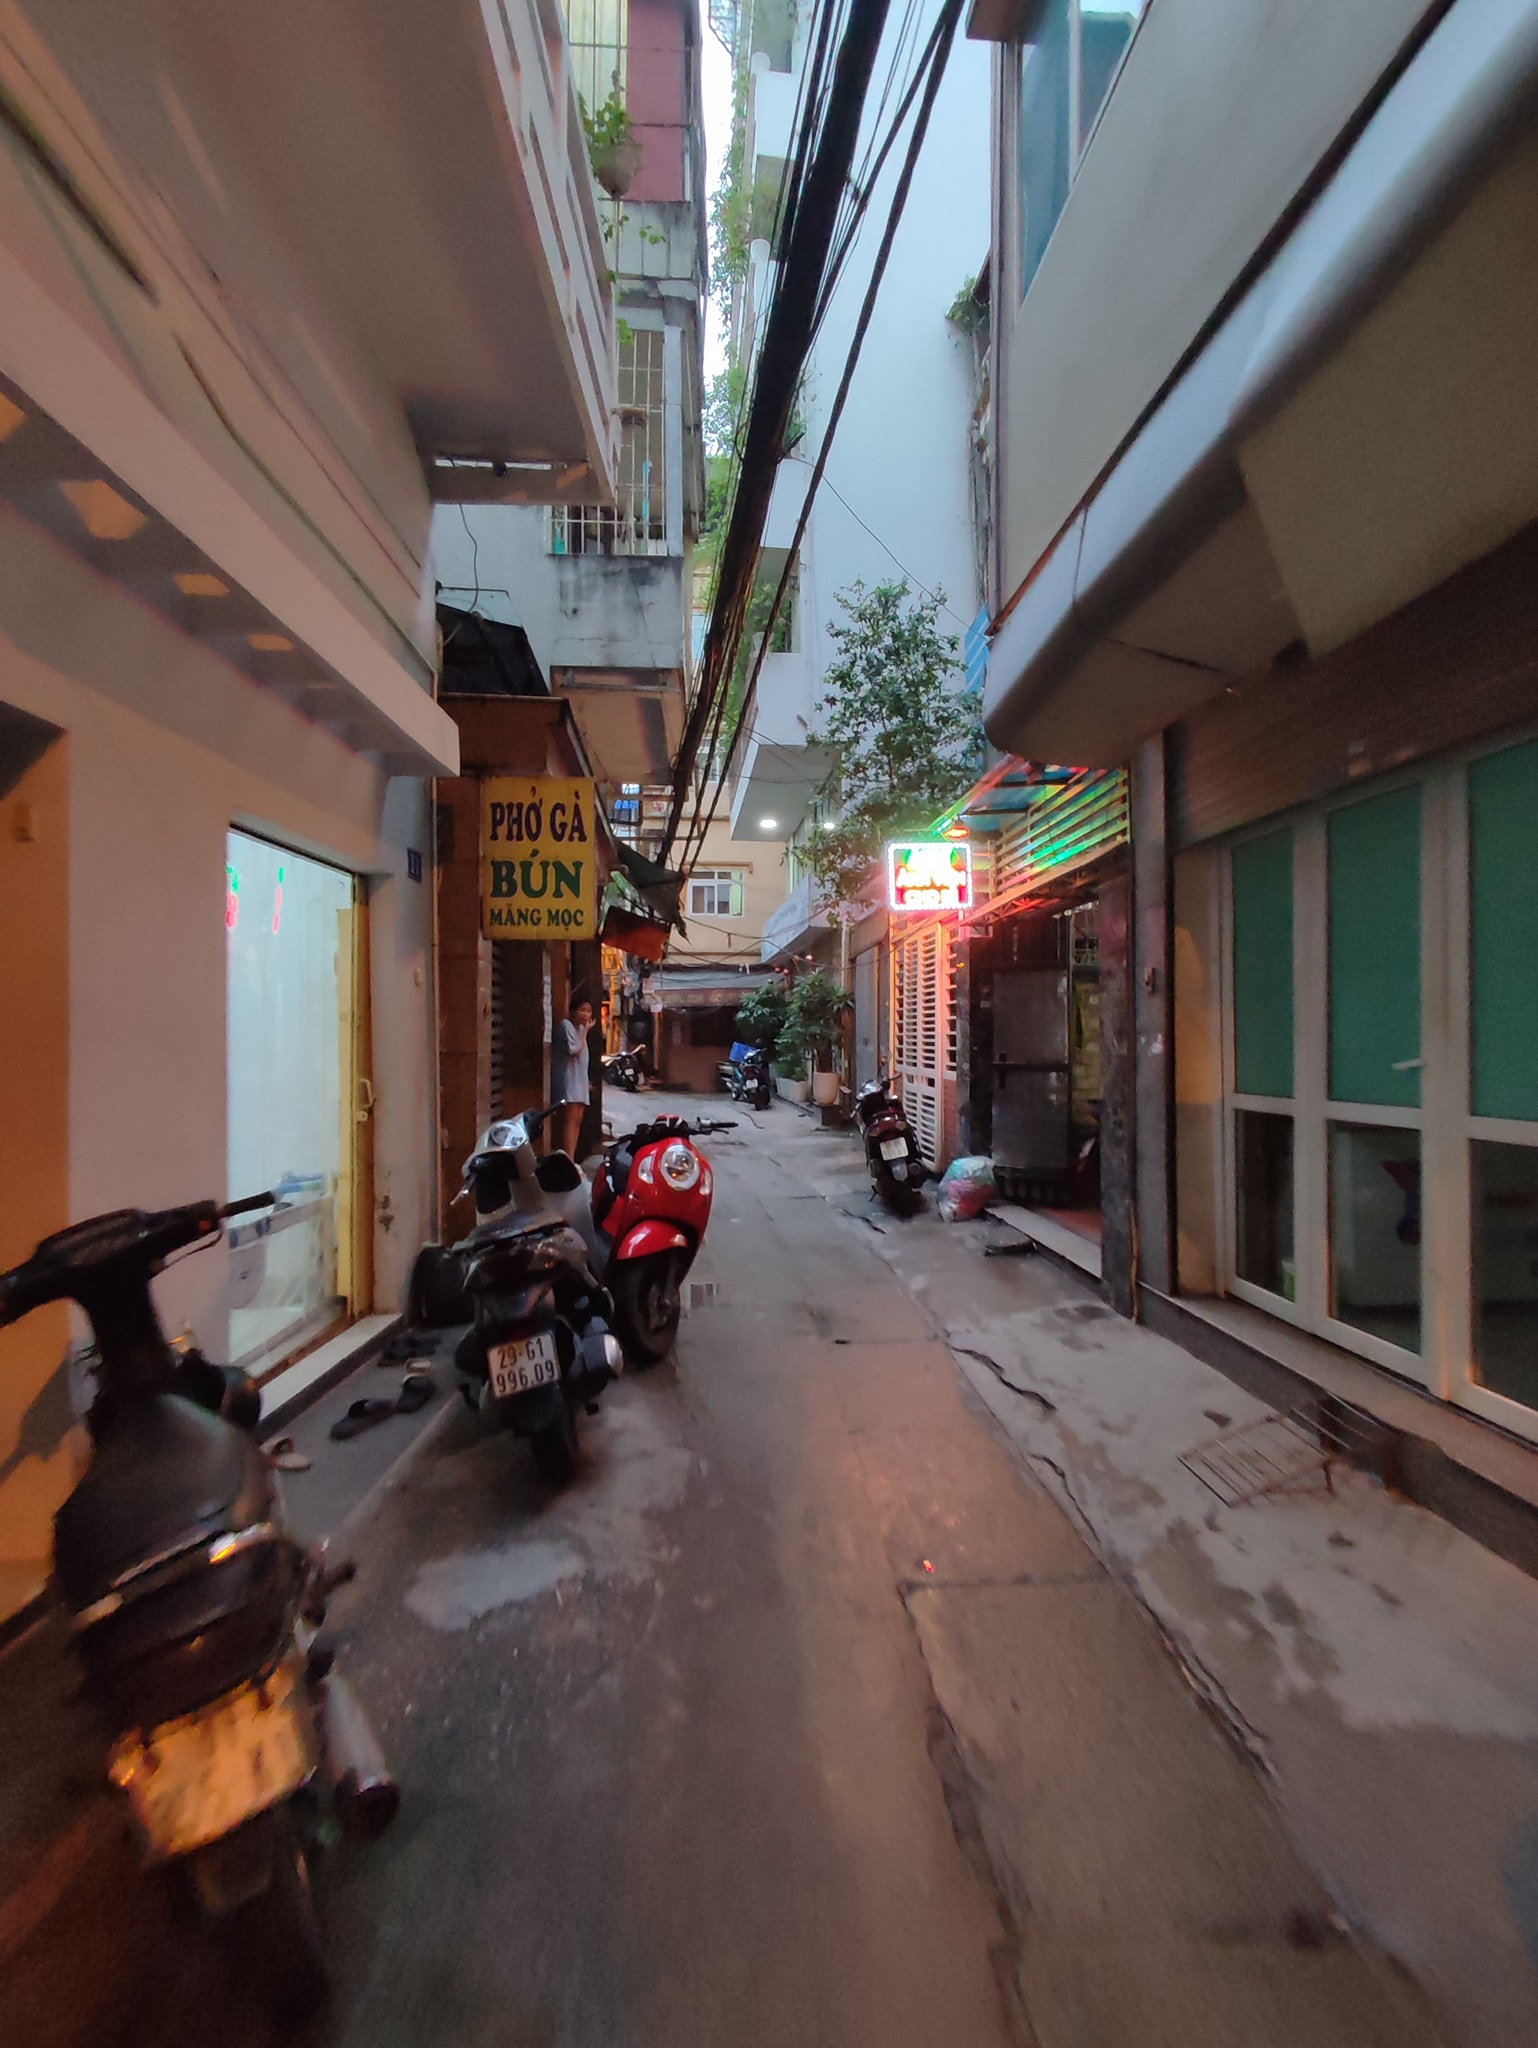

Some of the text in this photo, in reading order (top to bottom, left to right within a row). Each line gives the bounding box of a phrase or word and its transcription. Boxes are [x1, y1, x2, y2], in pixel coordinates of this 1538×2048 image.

[490, 786, 587, 842] PHỞ GÀ
[490, 849, 584, 899] BÚN
[490, 903, 584, 931] MĂNG MỌC
